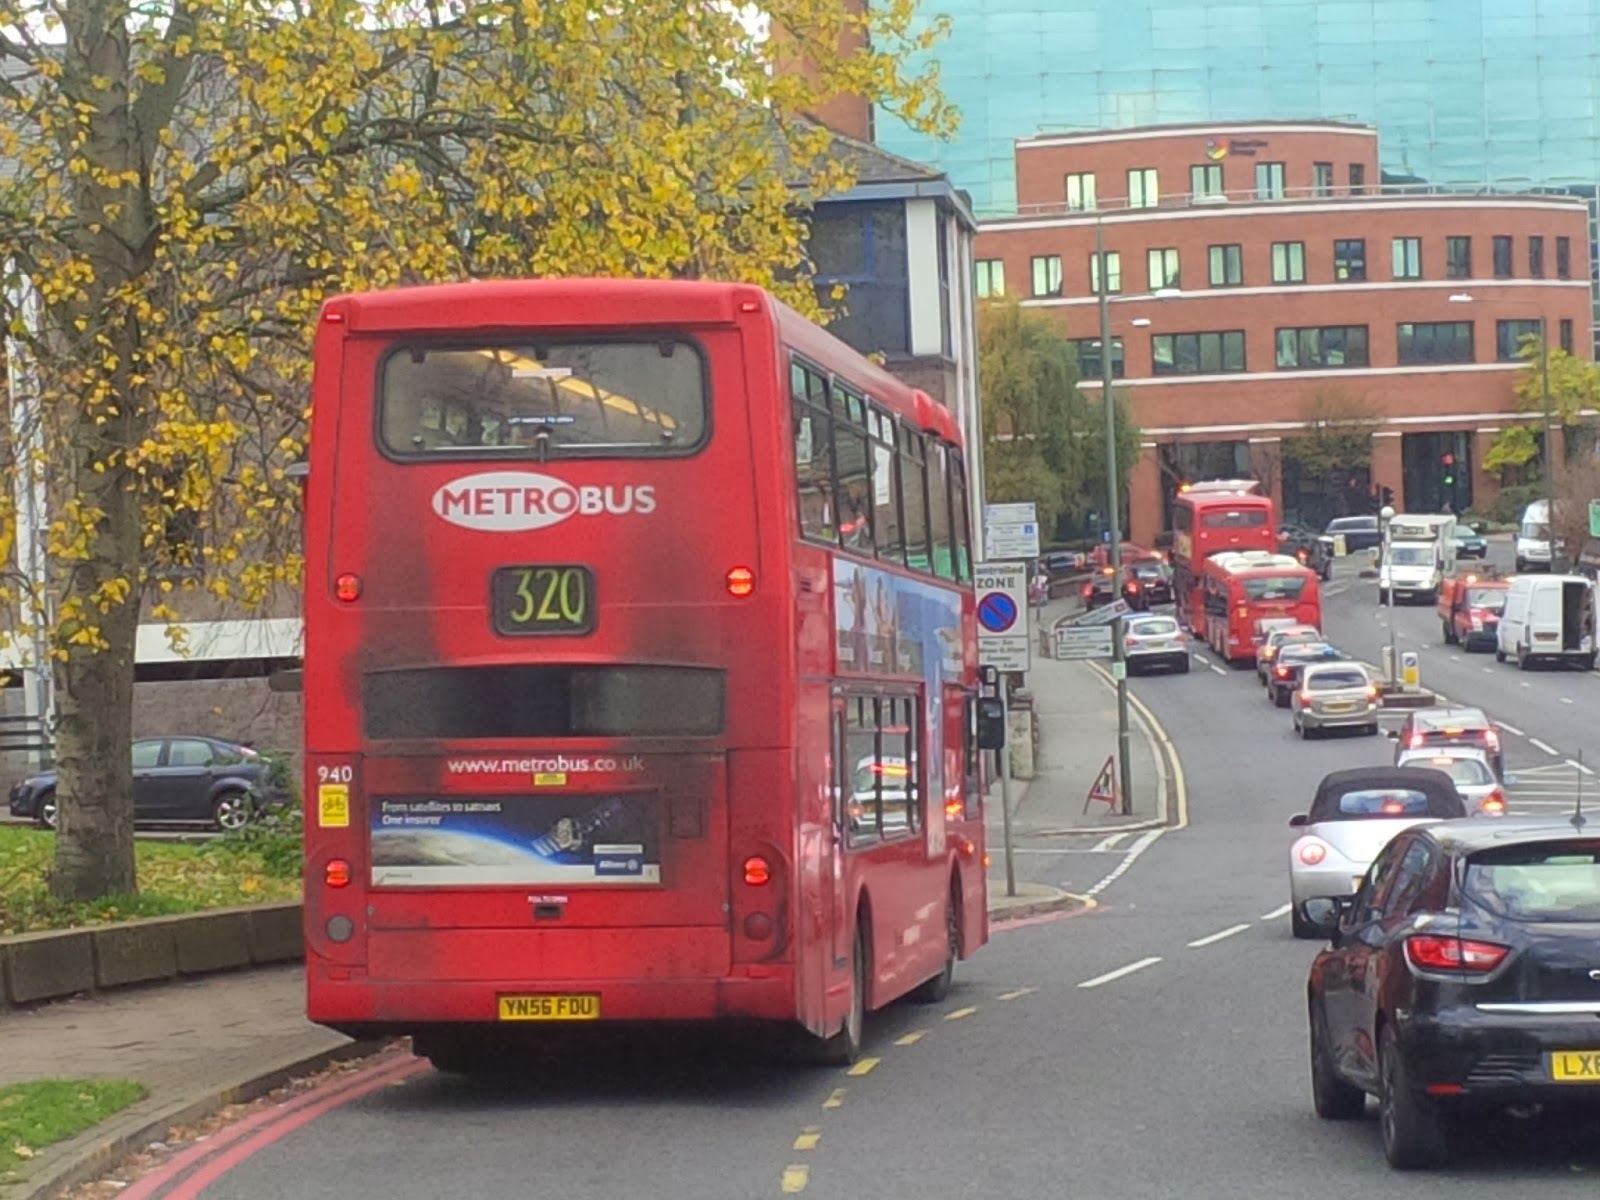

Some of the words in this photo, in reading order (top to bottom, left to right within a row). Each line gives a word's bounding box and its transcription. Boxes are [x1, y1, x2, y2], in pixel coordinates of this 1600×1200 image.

[441, 485, 656, 515] METROBUS
[976, 577, 1015, 588] ZONE
[510, 568, 585, 624] 320
[448, 755, 645, 773] www.metrobus.couk
[317, 765, 352, 783] 940
[505, 999, 552, 1015] YN56
[557, 999, 593, 1015] FDU
